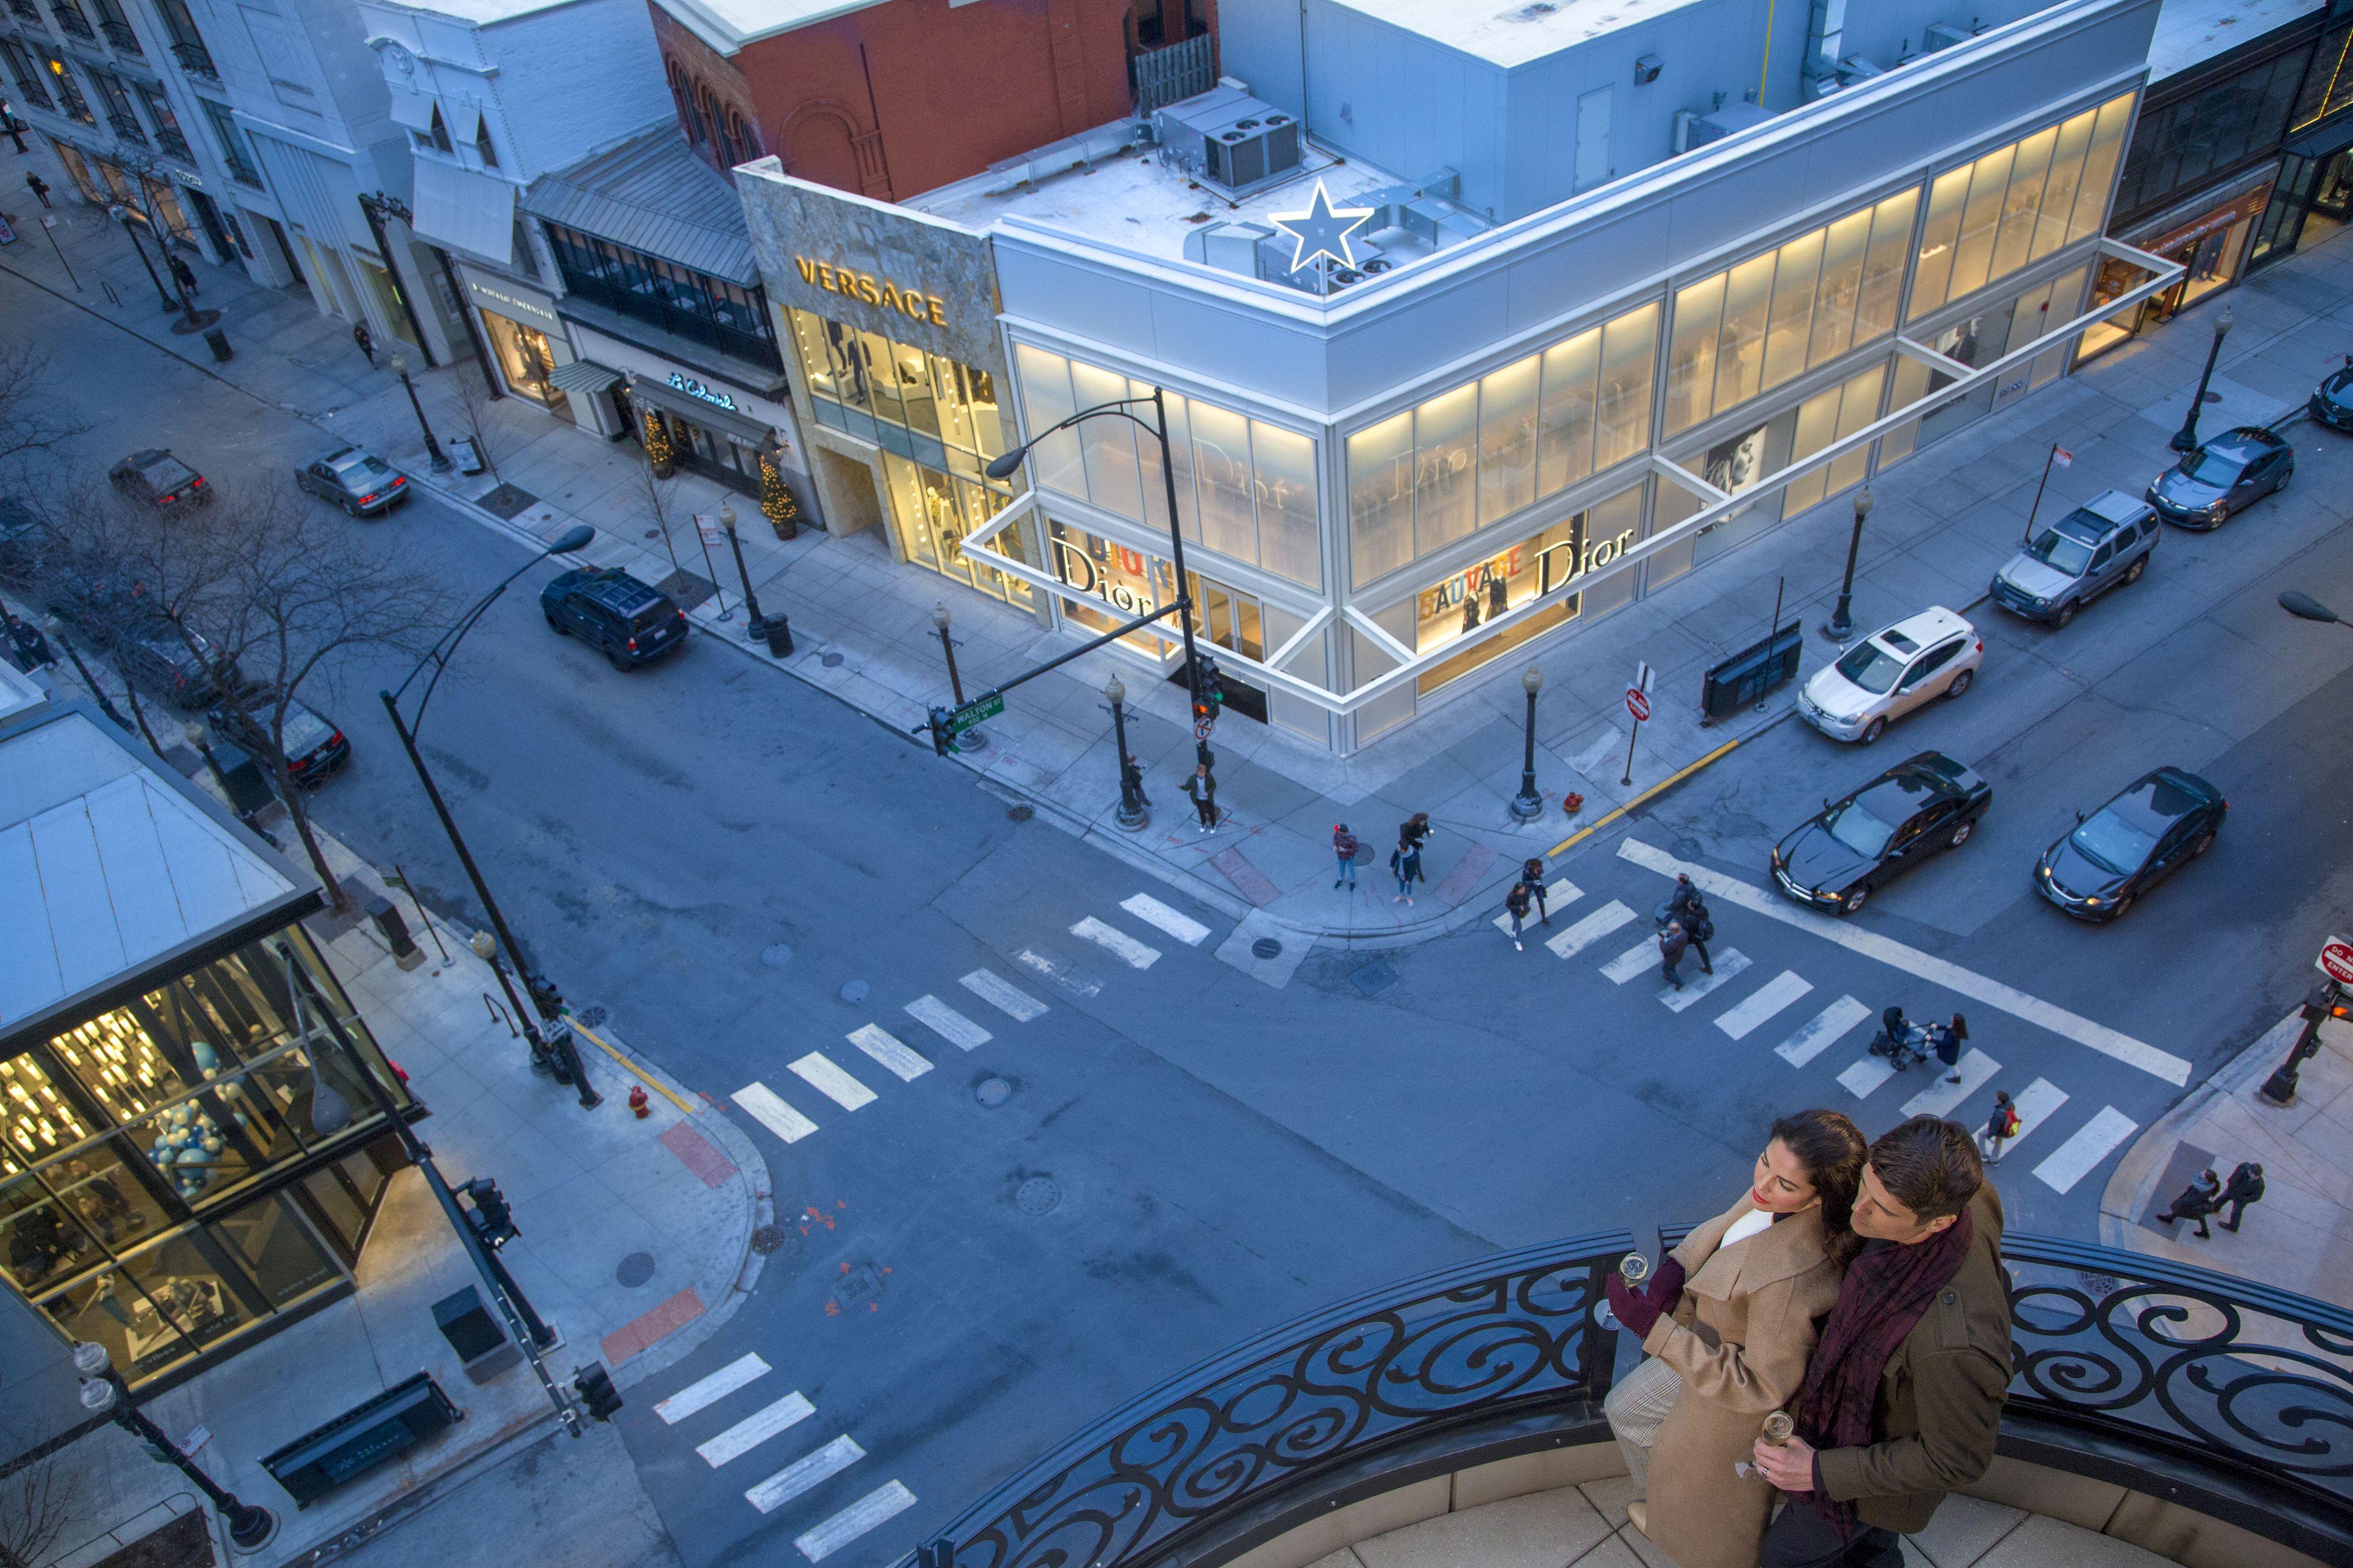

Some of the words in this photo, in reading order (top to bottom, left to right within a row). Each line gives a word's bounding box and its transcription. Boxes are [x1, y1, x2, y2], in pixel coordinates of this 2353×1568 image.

[795, 255, 948, 327] VERSACE
[1531, 528, 1634, 601] Dior
[1050, 537, 1153, 617] Dior
[1417, 543, 1523, 621] SAUVAGE
[1630, 690, 1637, 699] DO
[957, 702, 992, 724] WALTON
[1630, 703, 1645, 718] ENTER
[2332, 945, 2343, 956] DO
[2327, 960, 2353, 980] ENTER
